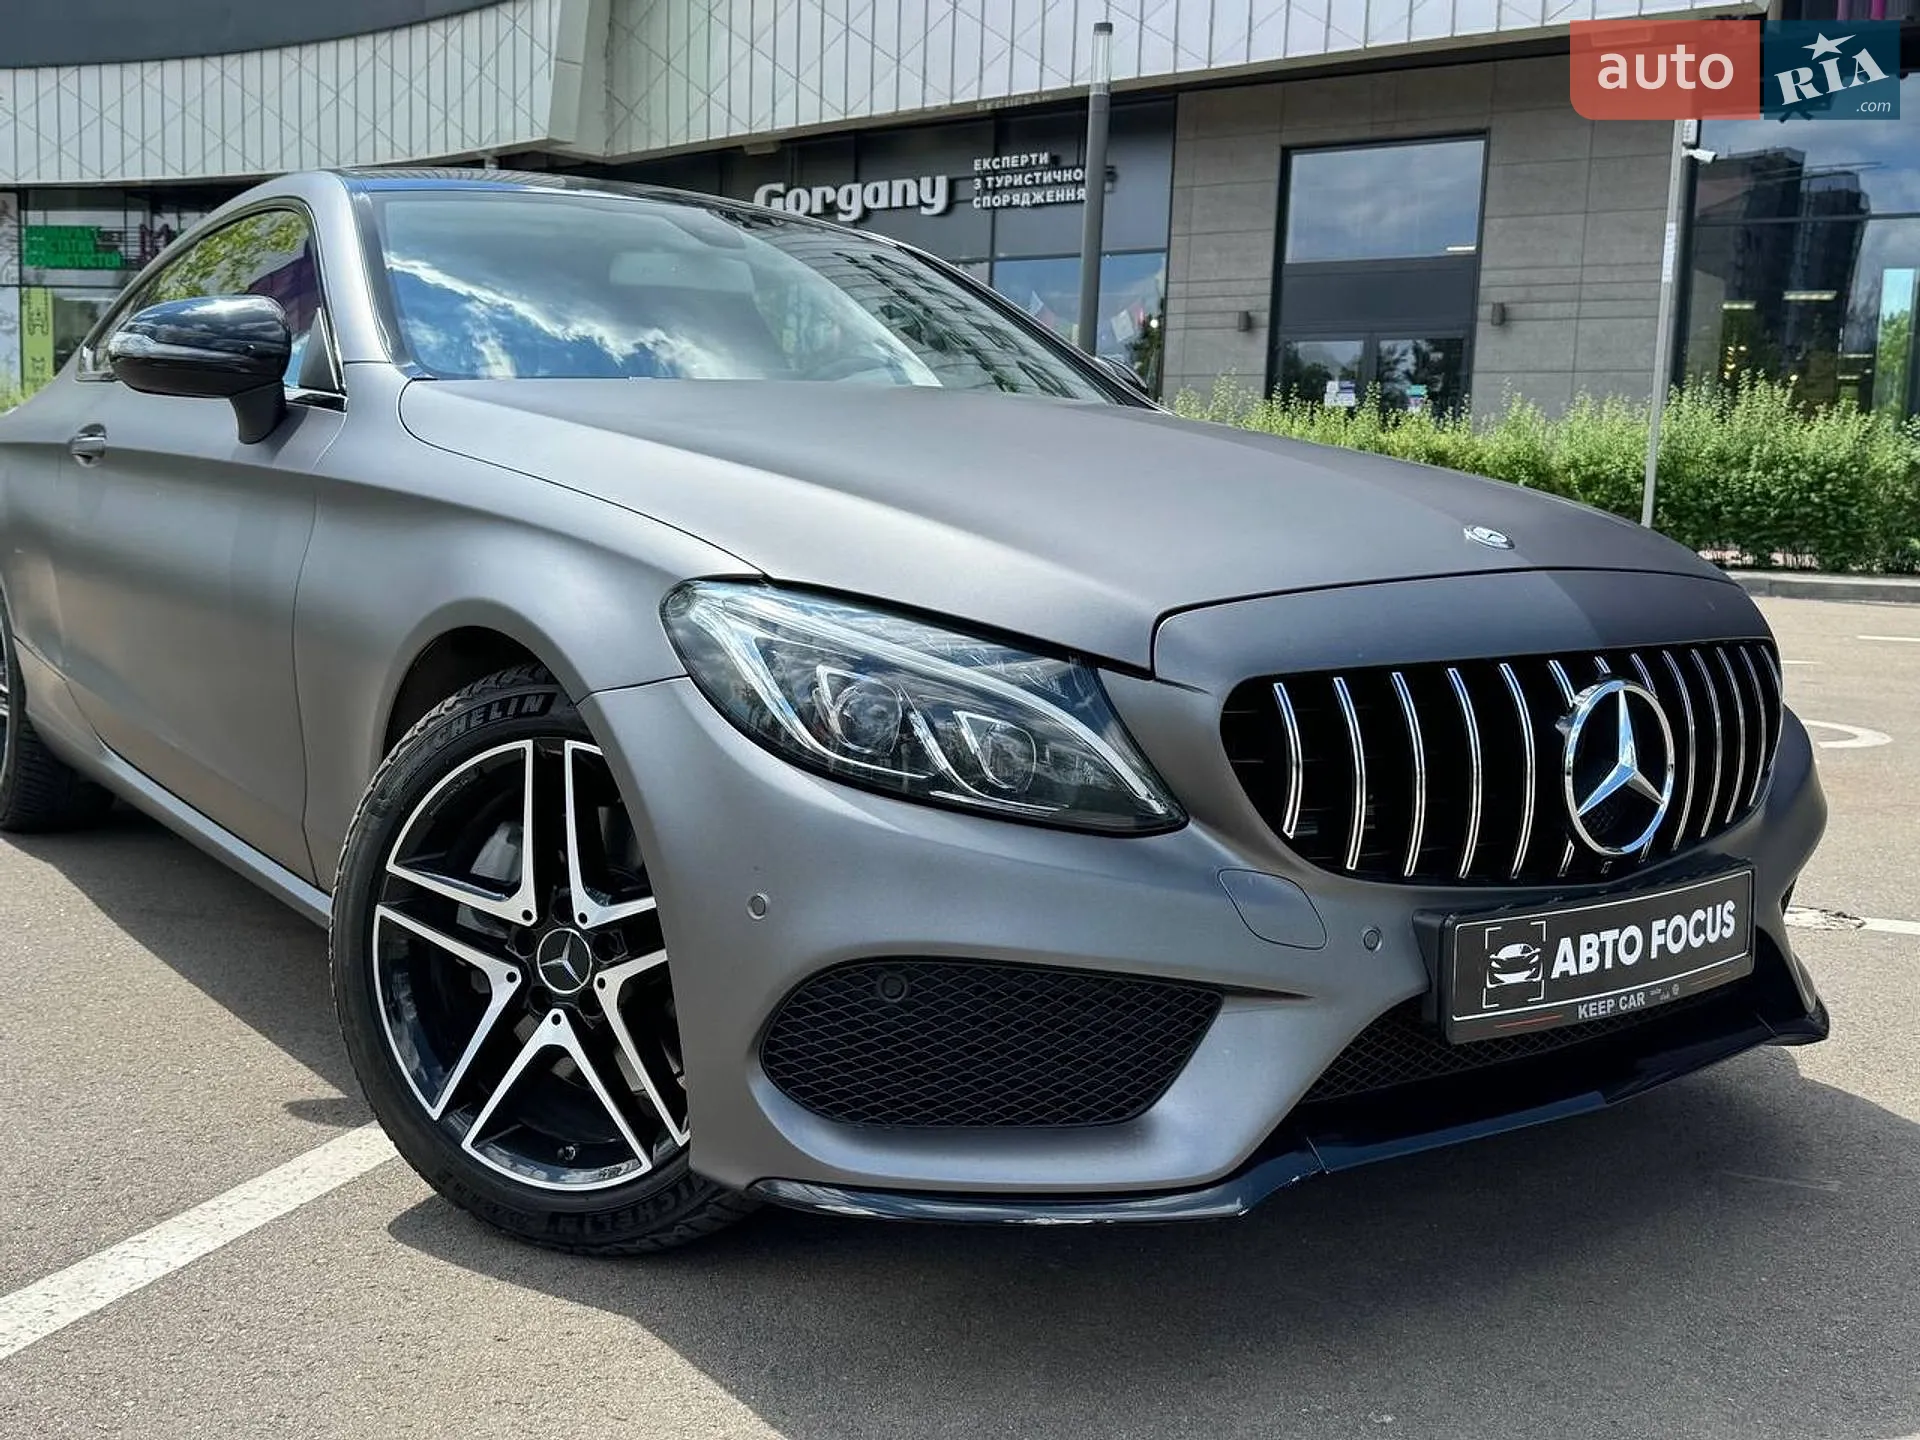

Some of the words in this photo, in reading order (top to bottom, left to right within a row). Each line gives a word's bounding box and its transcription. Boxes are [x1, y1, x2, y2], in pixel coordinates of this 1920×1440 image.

[973, 151, 1049, 171] ЕКСПЕРТИ
[985, 168, 1087, 189] ТУРИСТИЧНО
[754, 175, 948, 222] Gorgany
[973, 187, 1087, 209] СПОРЯДЖЕННЯ
[1550, 925, 1643, 979] АВТО
[1650, 900, 1736, 960] FOCUS
[1578, 999, 1614, 1020] KEEP
[1619, 992, 1646, 1011] CAR
